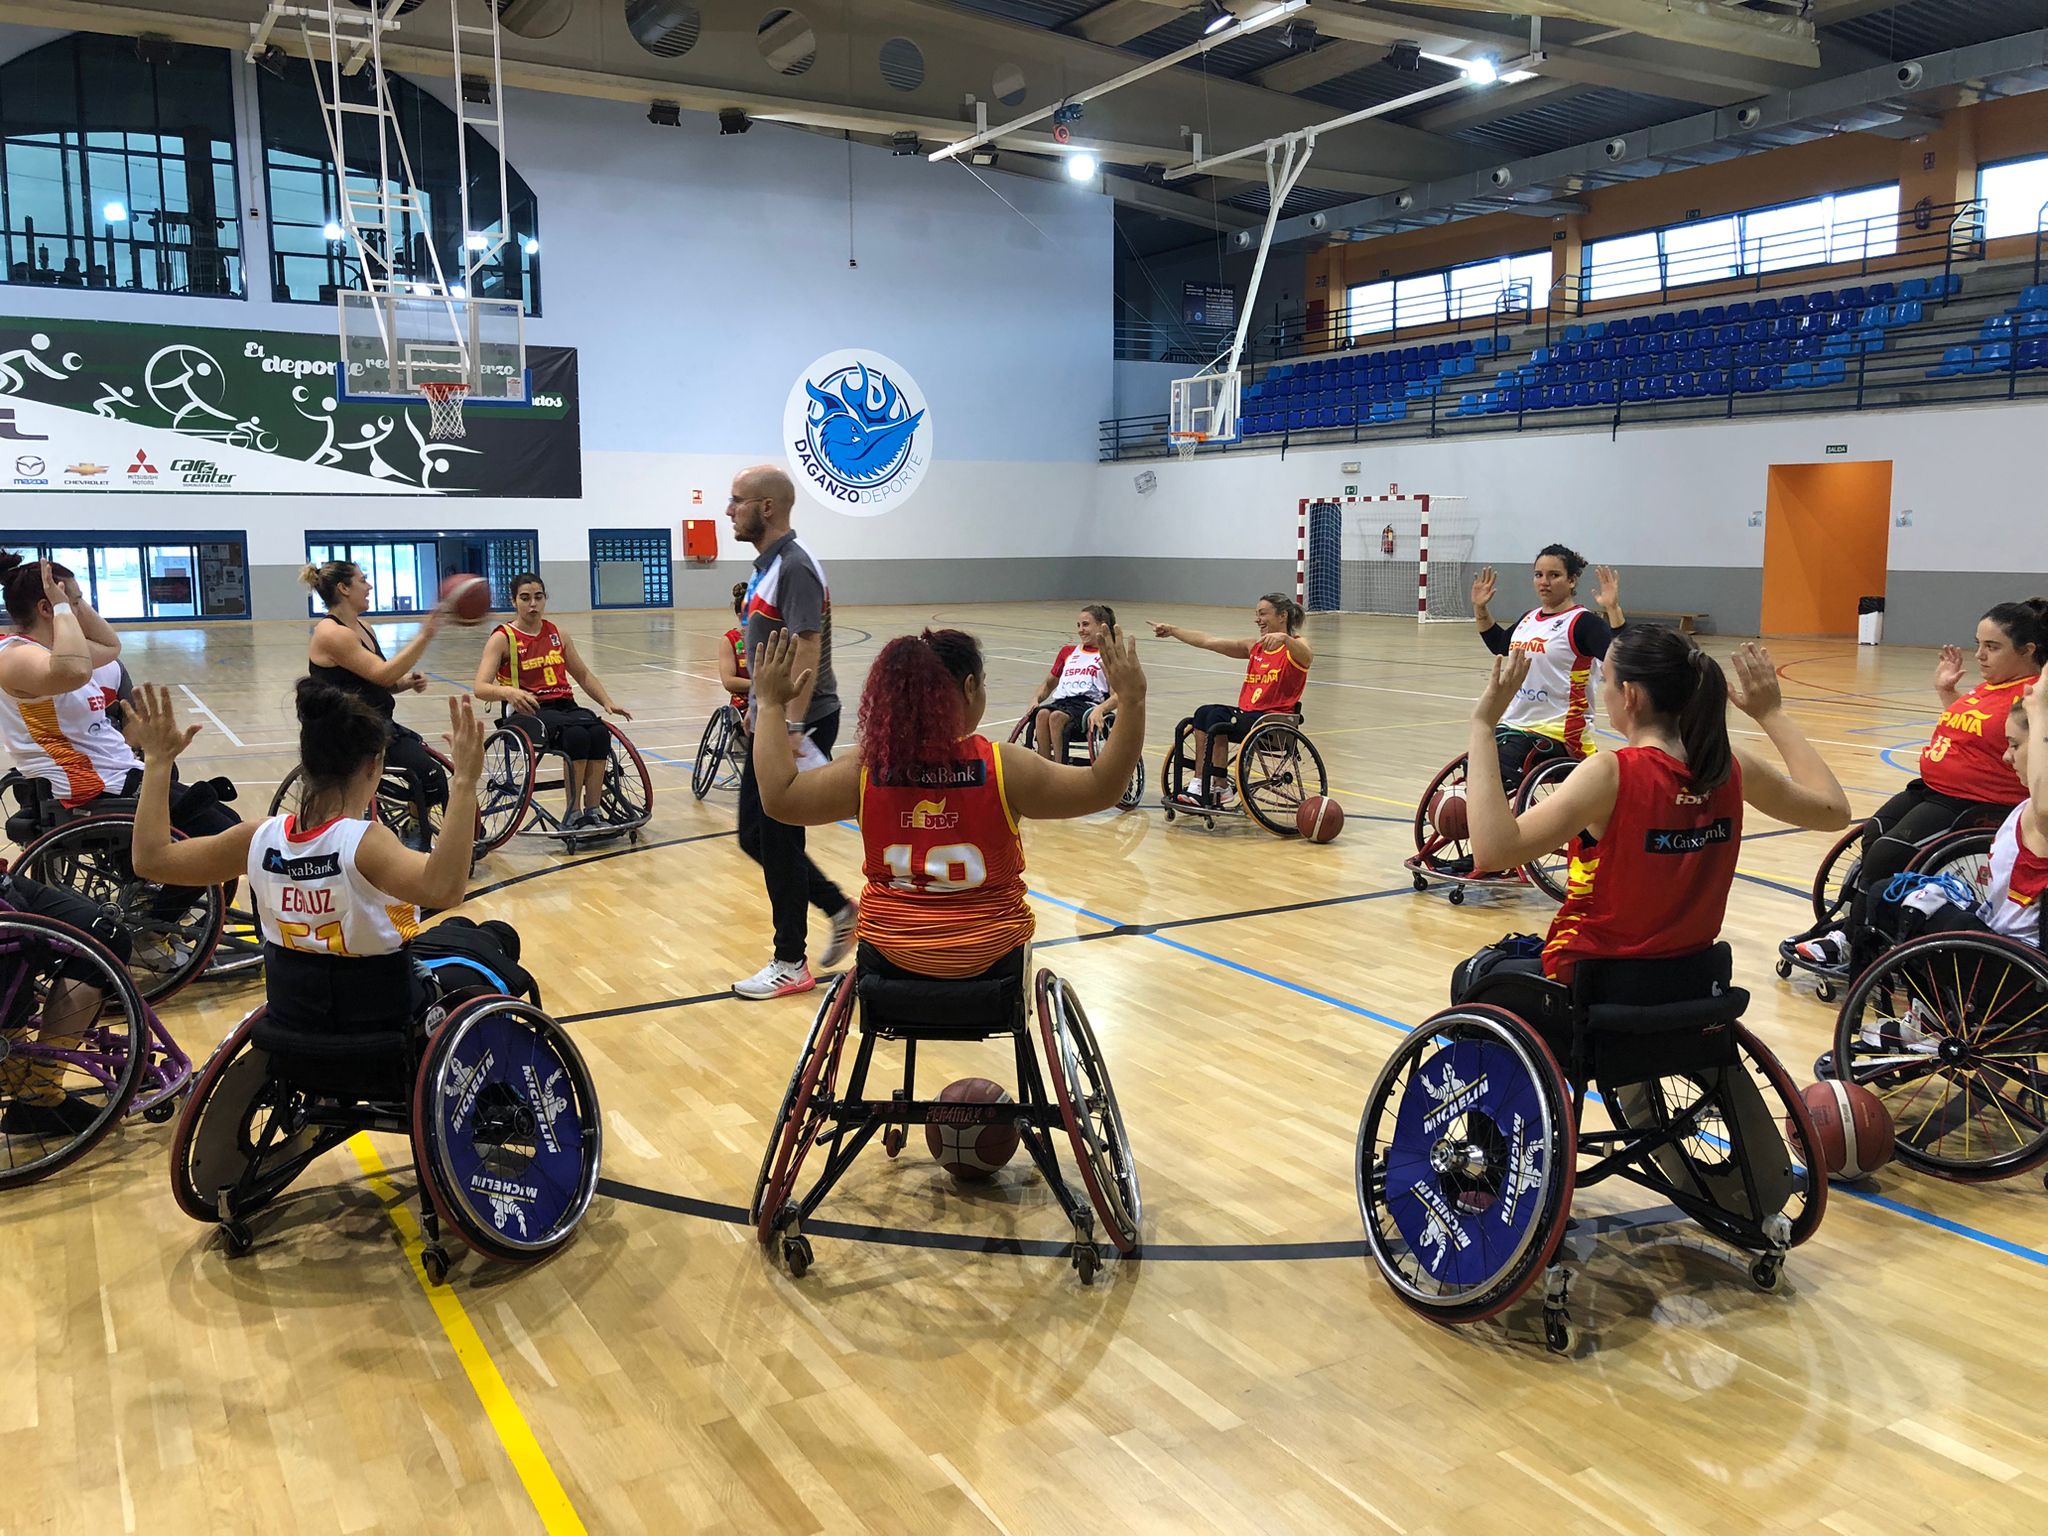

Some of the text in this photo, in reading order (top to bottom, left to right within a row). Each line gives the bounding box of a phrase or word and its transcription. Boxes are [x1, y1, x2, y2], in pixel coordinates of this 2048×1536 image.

[243, 341, 266, 358] El
[261, 355, 366, 380] depore
[182, 468, 238, 484] center
[543, 666, 558, 687] 8
[1064, 664, 1101, 679] ESPAÑA
[451, 1053, 495, 1135] MICHELIN
[1423, 1078, 1490, 1135] MICHELIN
[521, 1064, 558, 1154] MICHELIN
[1500, 1112, 1522, 1224] MICHELIN
[471, 1174, 539, 1199] MICHELIN
[1414, 1178, 1472, 1249] MICHELIN
